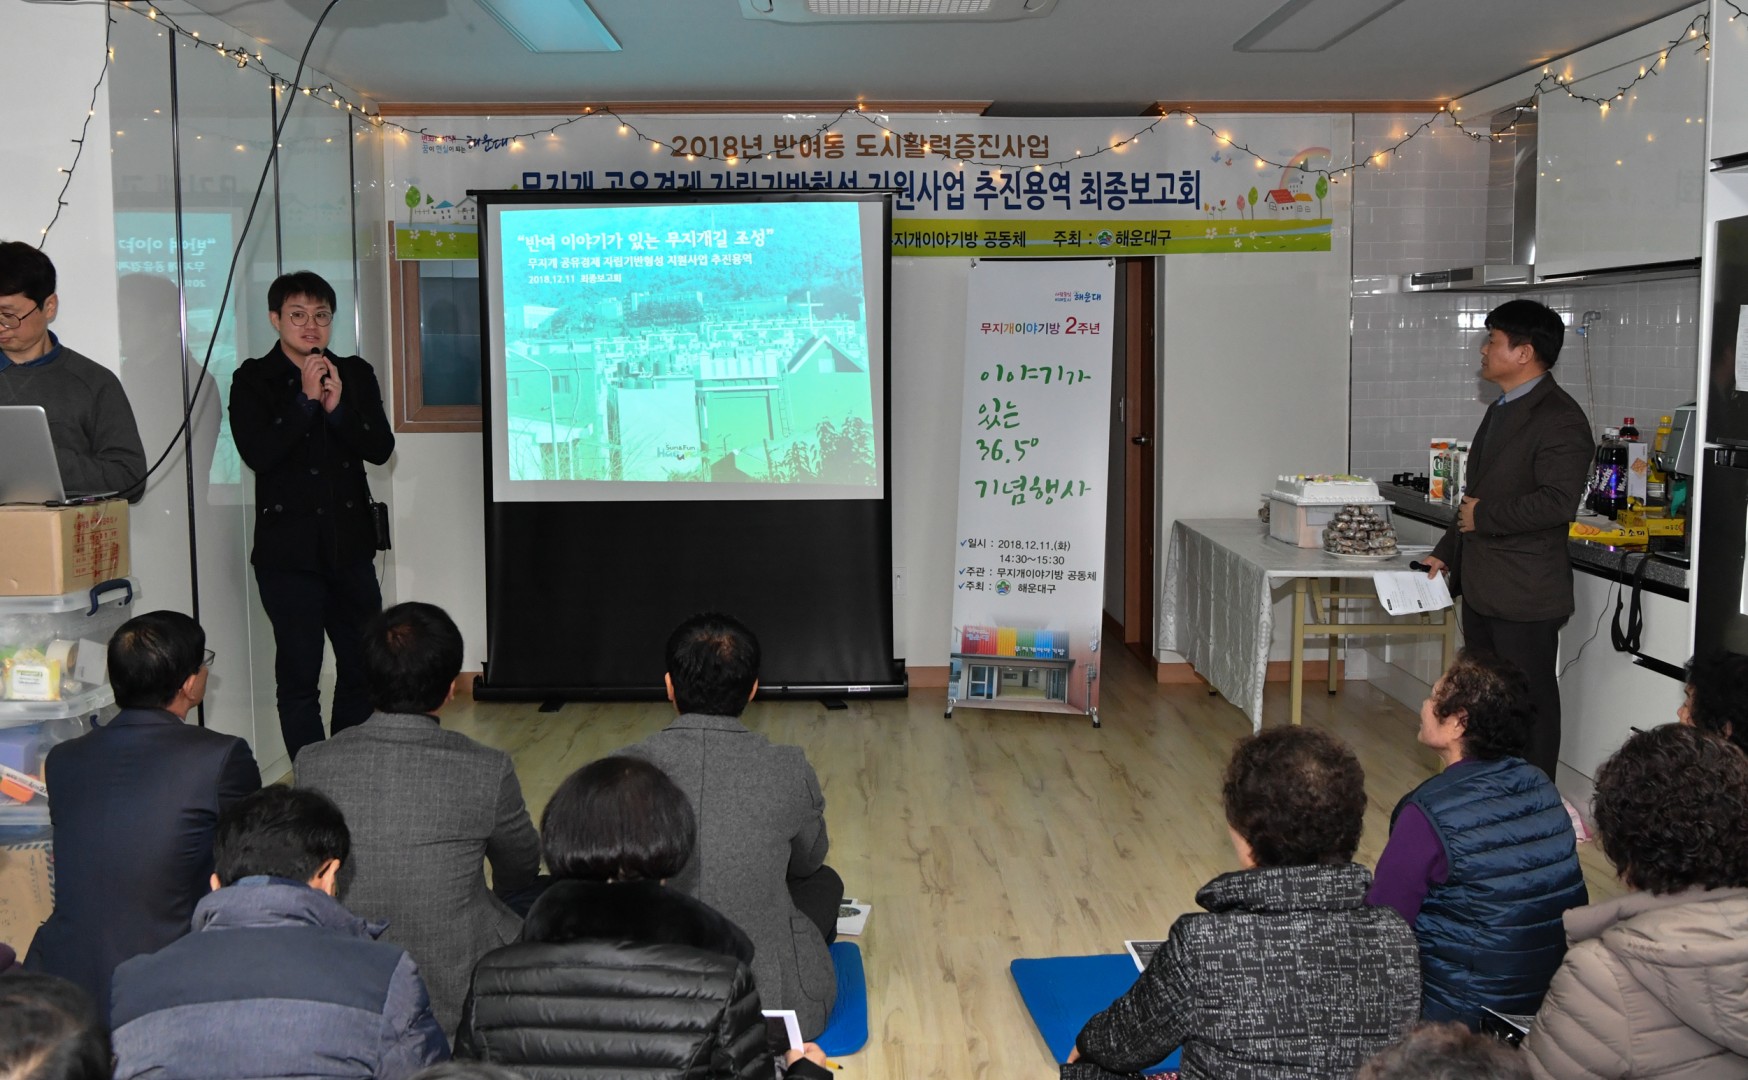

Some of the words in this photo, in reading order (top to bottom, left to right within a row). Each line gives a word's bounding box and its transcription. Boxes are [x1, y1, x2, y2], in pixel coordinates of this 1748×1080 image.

[671, 135, 762, 158] 2018년
[773, 134, 846, 159] 반여동
[855, 133, 1049, 159] 도시활력증진사업
[973, 170, 1071, 211] 추진용역
[1079, 170, 1201, 211] 최종보고회
[561, 231, 624, 251] 이야기가
[628, 231, 660, 250] 있는
[665, 229, 728, 249] 무지개길
[890, 230, 979, 248] 지개이야기방
[983, 230, 1026, 248] 공동체
[1052, 230, 1081, 248] 주최
[1115, 229, 1172, 248] 해운대구
[528, 257, 558, 269] 무지개
[560, 256, 601, 269] 공유경제
[667, 253, 709, 267] 지원사업
[711, 252, 753, 266] 추진용역
[1074, 291, 1102, 303] 해운대
[980, 322, 1060, 335] 무지개이야기방
[1065, 316, 1101, 335] 2주년
[980, 364, 1092, 385] 이야기가
[978, 398, 1020, 430] 있는
[974, 475, 1092, 506] 기념행사
[967, 538, 987, 549] 일시
[965, 567, 985, 578] 주관
[996, 567, 1064, 581] 무지개이야기방
[1067, 570, 1097, 582] 공동체
[965, 581, 985, 592] 주최
[1017, 583, 1057, 594] 해운대구
